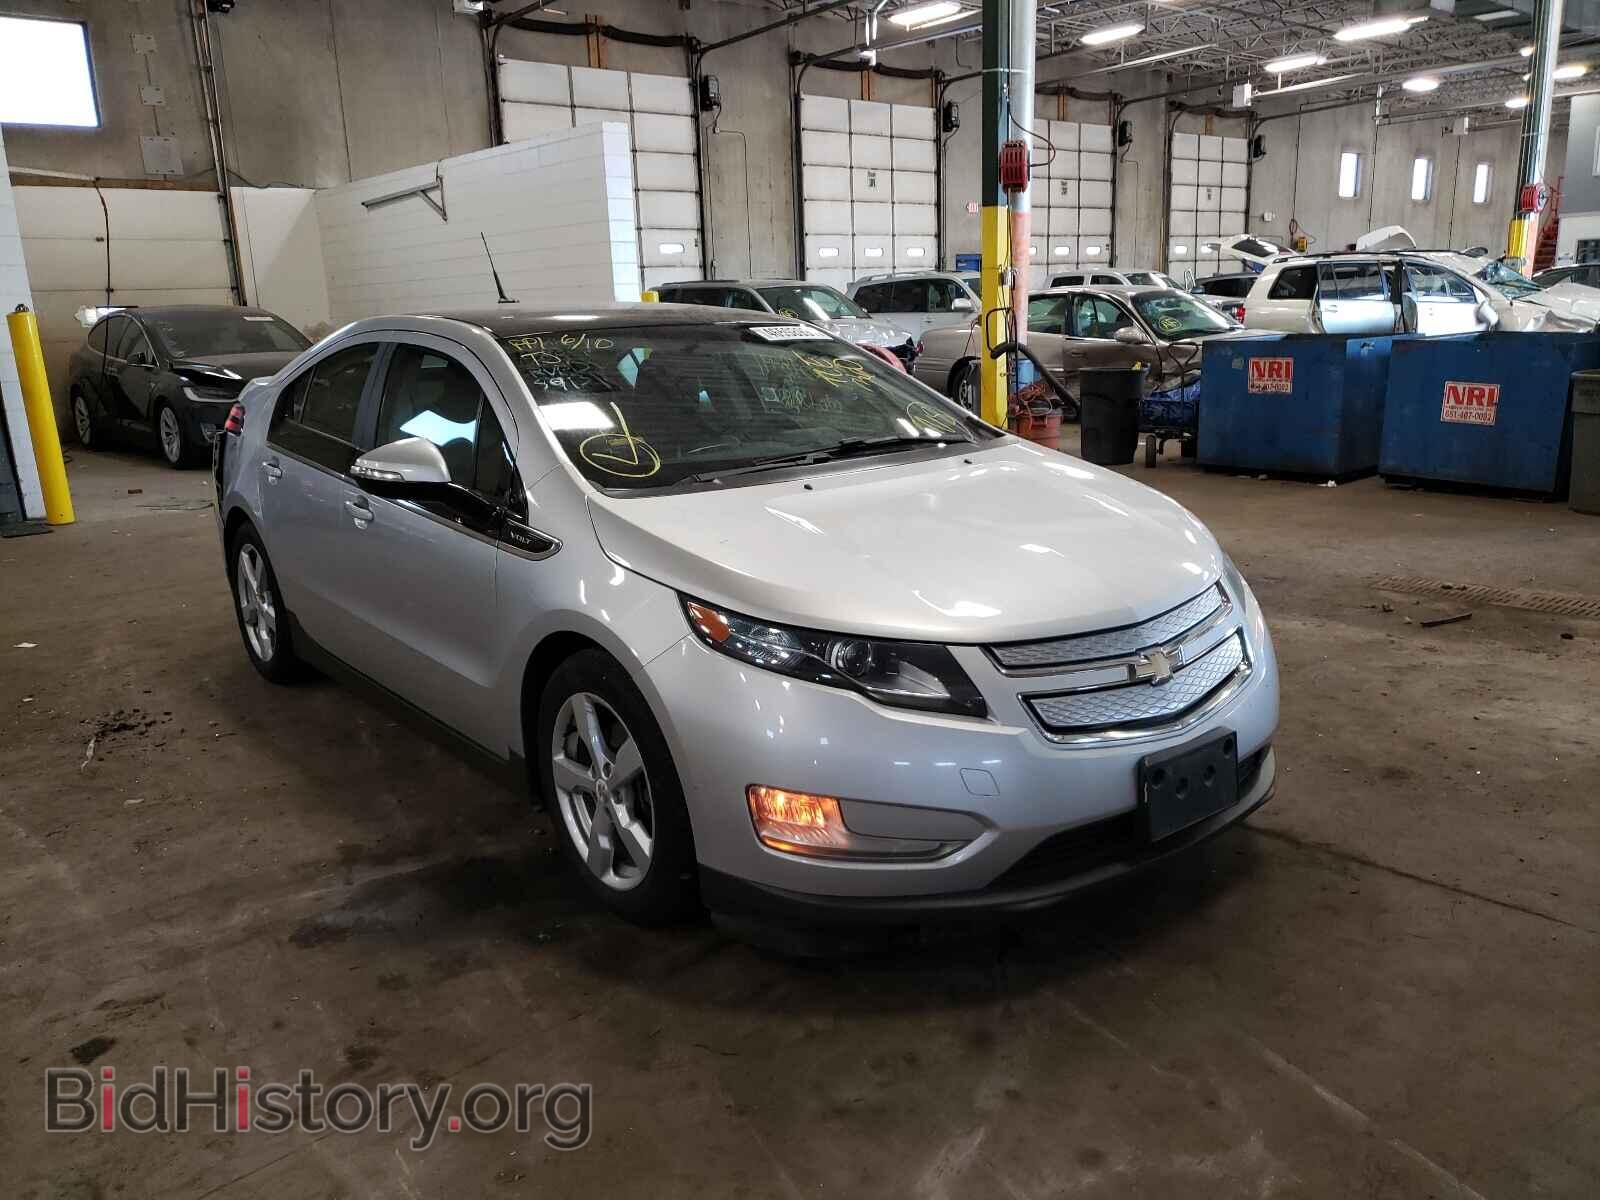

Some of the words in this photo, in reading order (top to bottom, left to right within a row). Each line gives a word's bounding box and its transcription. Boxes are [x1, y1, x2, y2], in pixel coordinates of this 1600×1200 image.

[1251, 360, 1291, 378] NRI
[1446, 386, 1496, 407] NRI
[510, 531, 532, 544] VOLT
